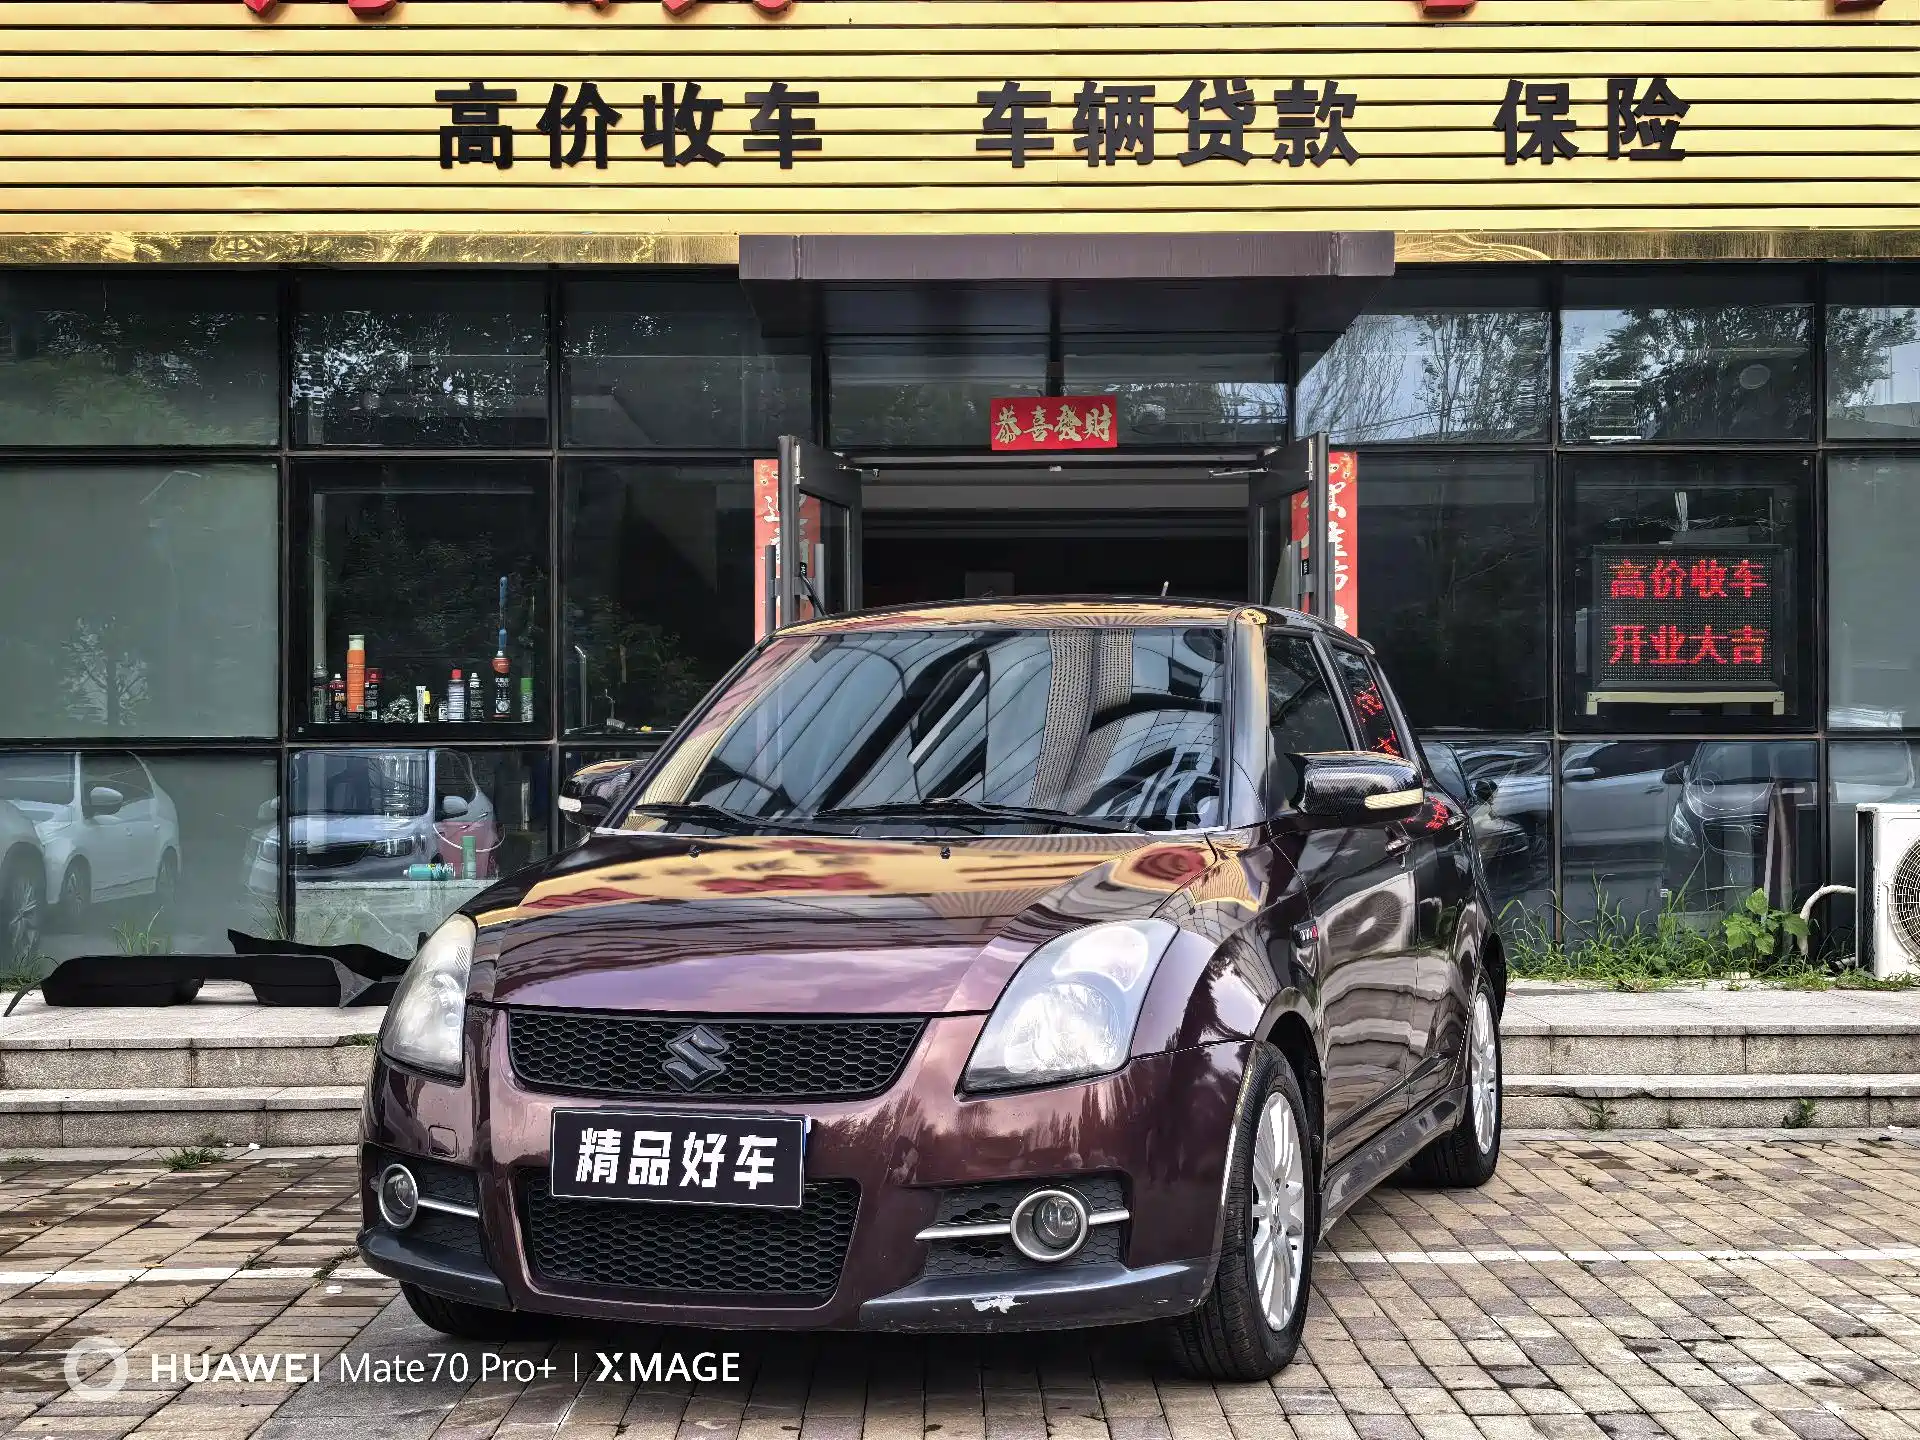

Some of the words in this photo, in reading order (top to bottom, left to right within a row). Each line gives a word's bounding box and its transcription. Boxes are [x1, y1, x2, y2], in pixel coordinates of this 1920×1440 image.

[435, 80, 823, 169] 高价收车
[976, 78, 1360, 168] 车辆贷款
[1493, 77, 1691, 166] 保险
[995, 404, 1112, 444] 恭喜發財
[1609, 558, 1767, 599] 高价收车
[1608, 625, 1767, 665] 开业大吉
[575, 1127, 778, 1191] 精品好车
